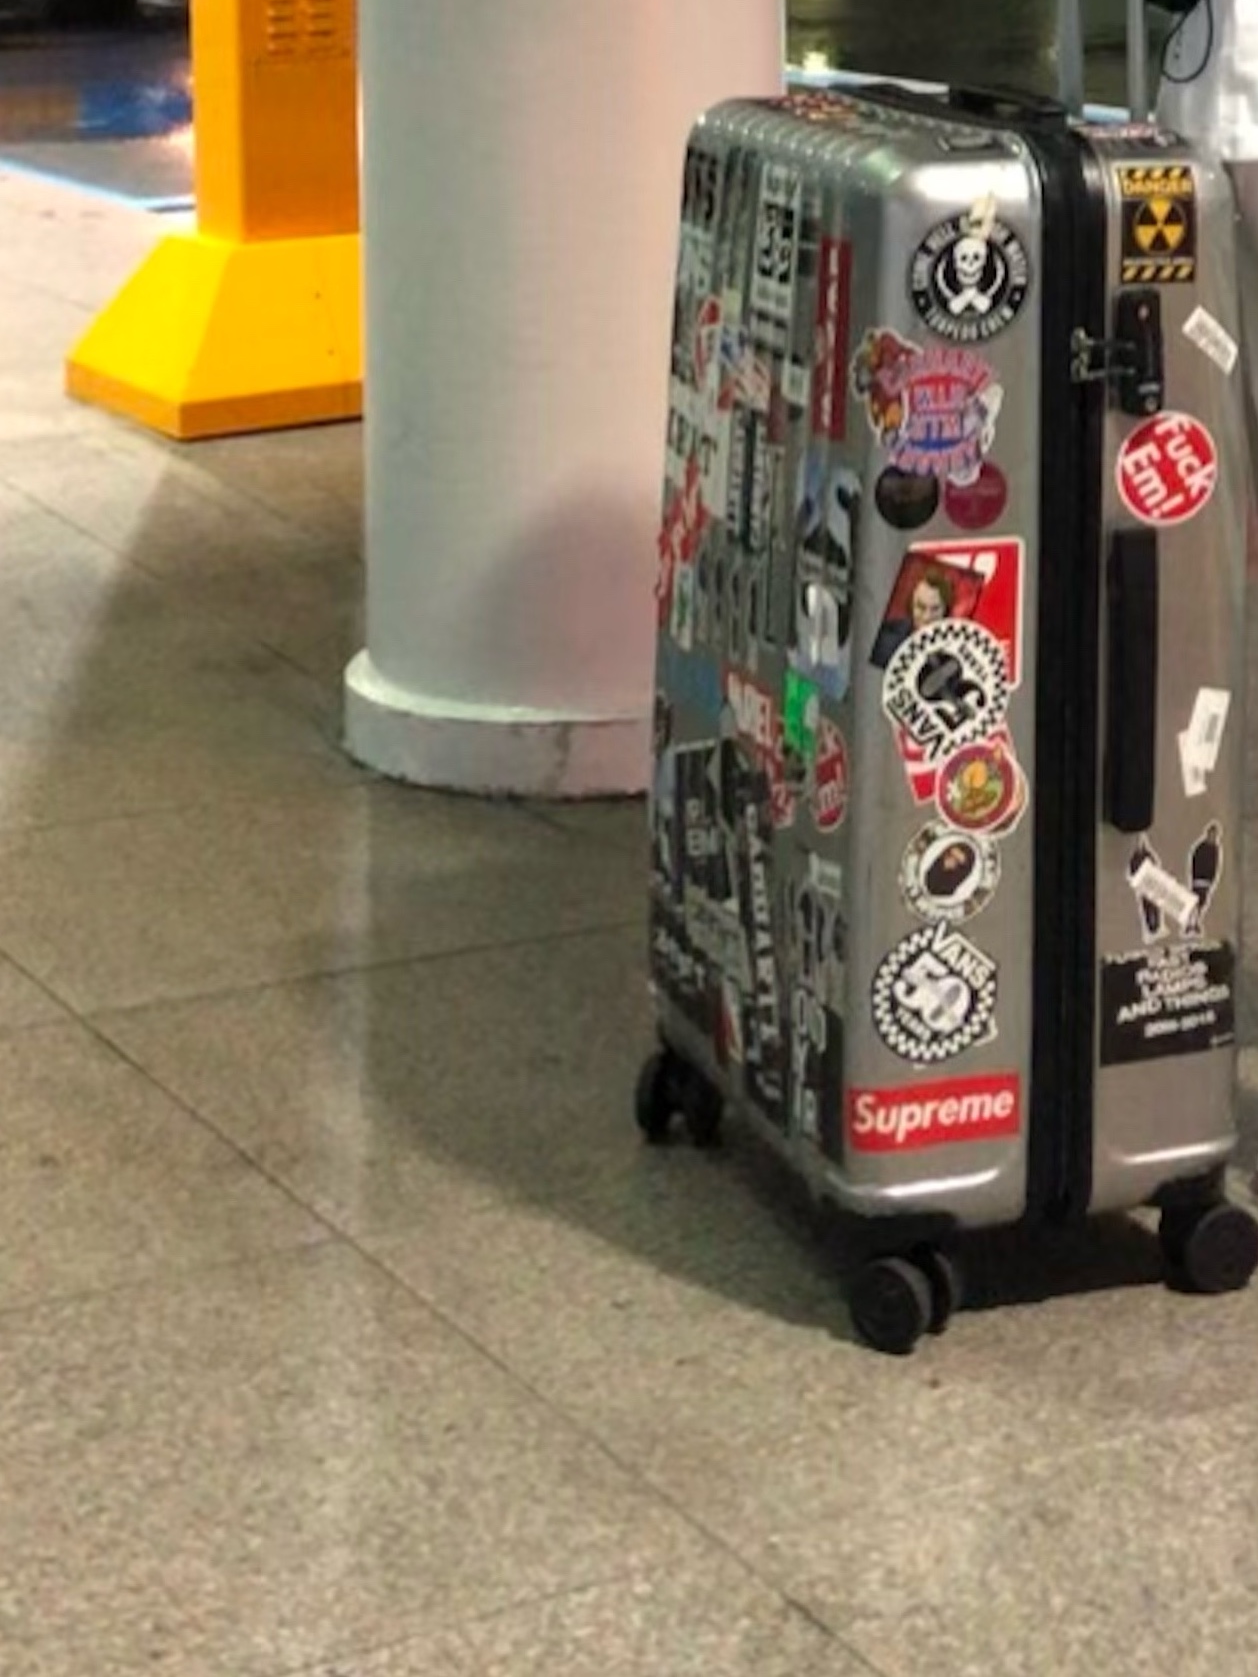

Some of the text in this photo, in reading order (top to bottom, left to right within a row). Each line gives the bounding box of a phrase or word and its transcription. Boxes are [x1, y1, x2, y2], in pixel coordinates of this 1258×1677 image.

[1122, 441, 1185, 519] Em!
[1154, 415, 1216, 499] Fuck
[885, 687, 944, 763] VANS
[931, 920, 996, 991] VANS
[1117, 998, 1162, 1023] AND
[852, 1089, 1015, 1144] Supreme
